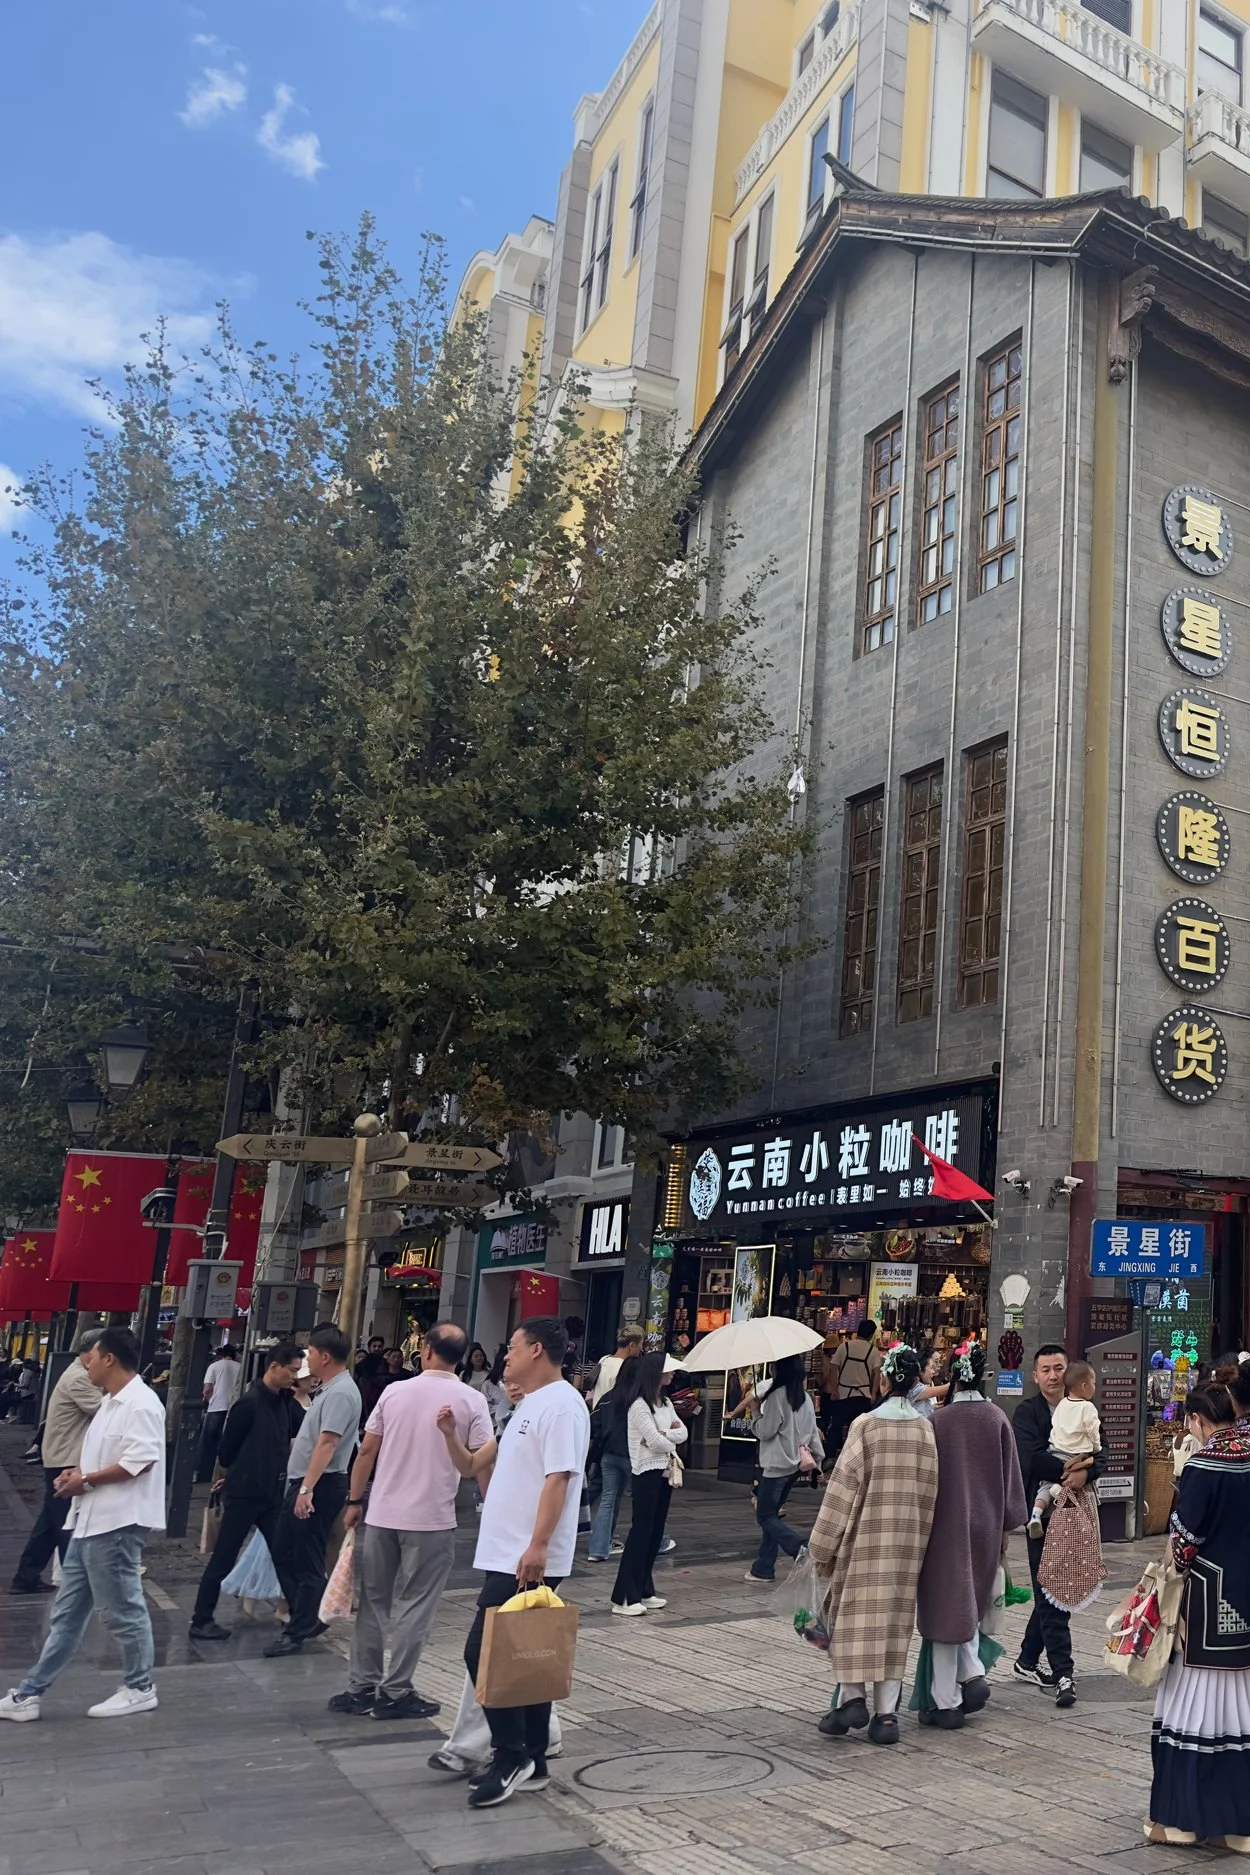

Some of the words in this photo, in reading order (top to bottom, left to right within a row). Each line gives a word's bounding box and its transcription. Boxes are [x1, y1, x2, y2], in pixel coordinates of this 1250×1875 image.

[264, 1138, 306, 1151] 庆云街
[426, 1147, 463, 1159] 景星街
[727, 1109, 960, 1191] 云南小粒咖啡
[726, 1200, 775, 1215] Yunnan
[777, 1190, 826, 1210] coffee
[836, 1183, 889, 1205] 表里如一
[589, 1204, 623, 1255] HLA
[507, 1222, 546, 1258] 植物医生
[1107, 1226, 1192, 1258] 景星街
[876, 1268, 913, 1276] 云南小粒咖啡
[1098, 1262, 1107, 1272] 东
[1118, 1262, 1156, 1273] JINGXING
[1168, 1263, 1180, 1273] JIE
[1190, 1263, 1198, 1273] 西
